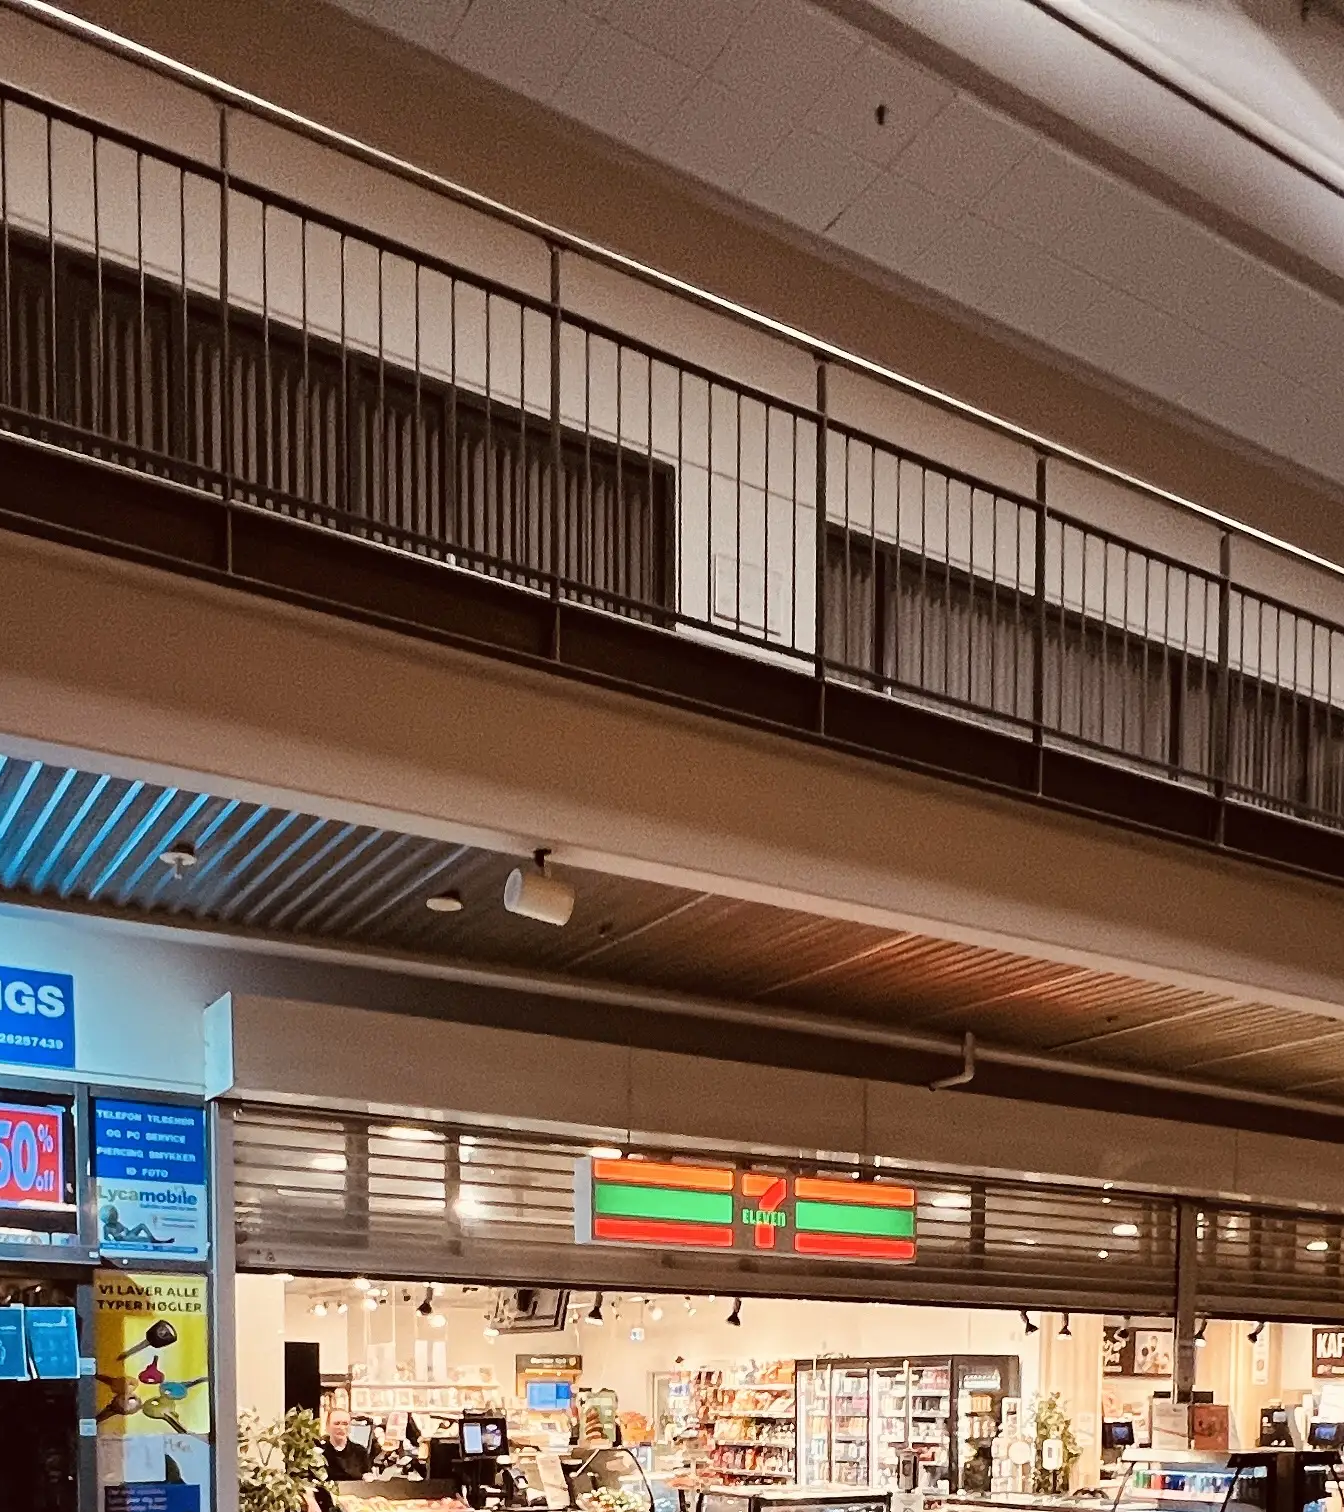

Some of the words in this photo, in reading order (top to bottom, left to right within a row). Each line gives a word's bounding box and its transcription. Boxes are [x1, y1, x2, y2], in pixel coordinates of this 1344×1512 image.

[96, 1109, 142, 1122] TELEFON
[142, 1168, 169, 1179] FOTO
[35, 1170, 55, 1193] off
[97, 1186, 198, 1206] Lycamobile
[99, 1284, 114, 1296] VI
[117, 1284, 163, 1298] LAVER
[167, 1286, 199, 1298] ALLE
[97, 1299, 143, 1311] TYPER
[146, 1300, 202, 1313] NØGLER
